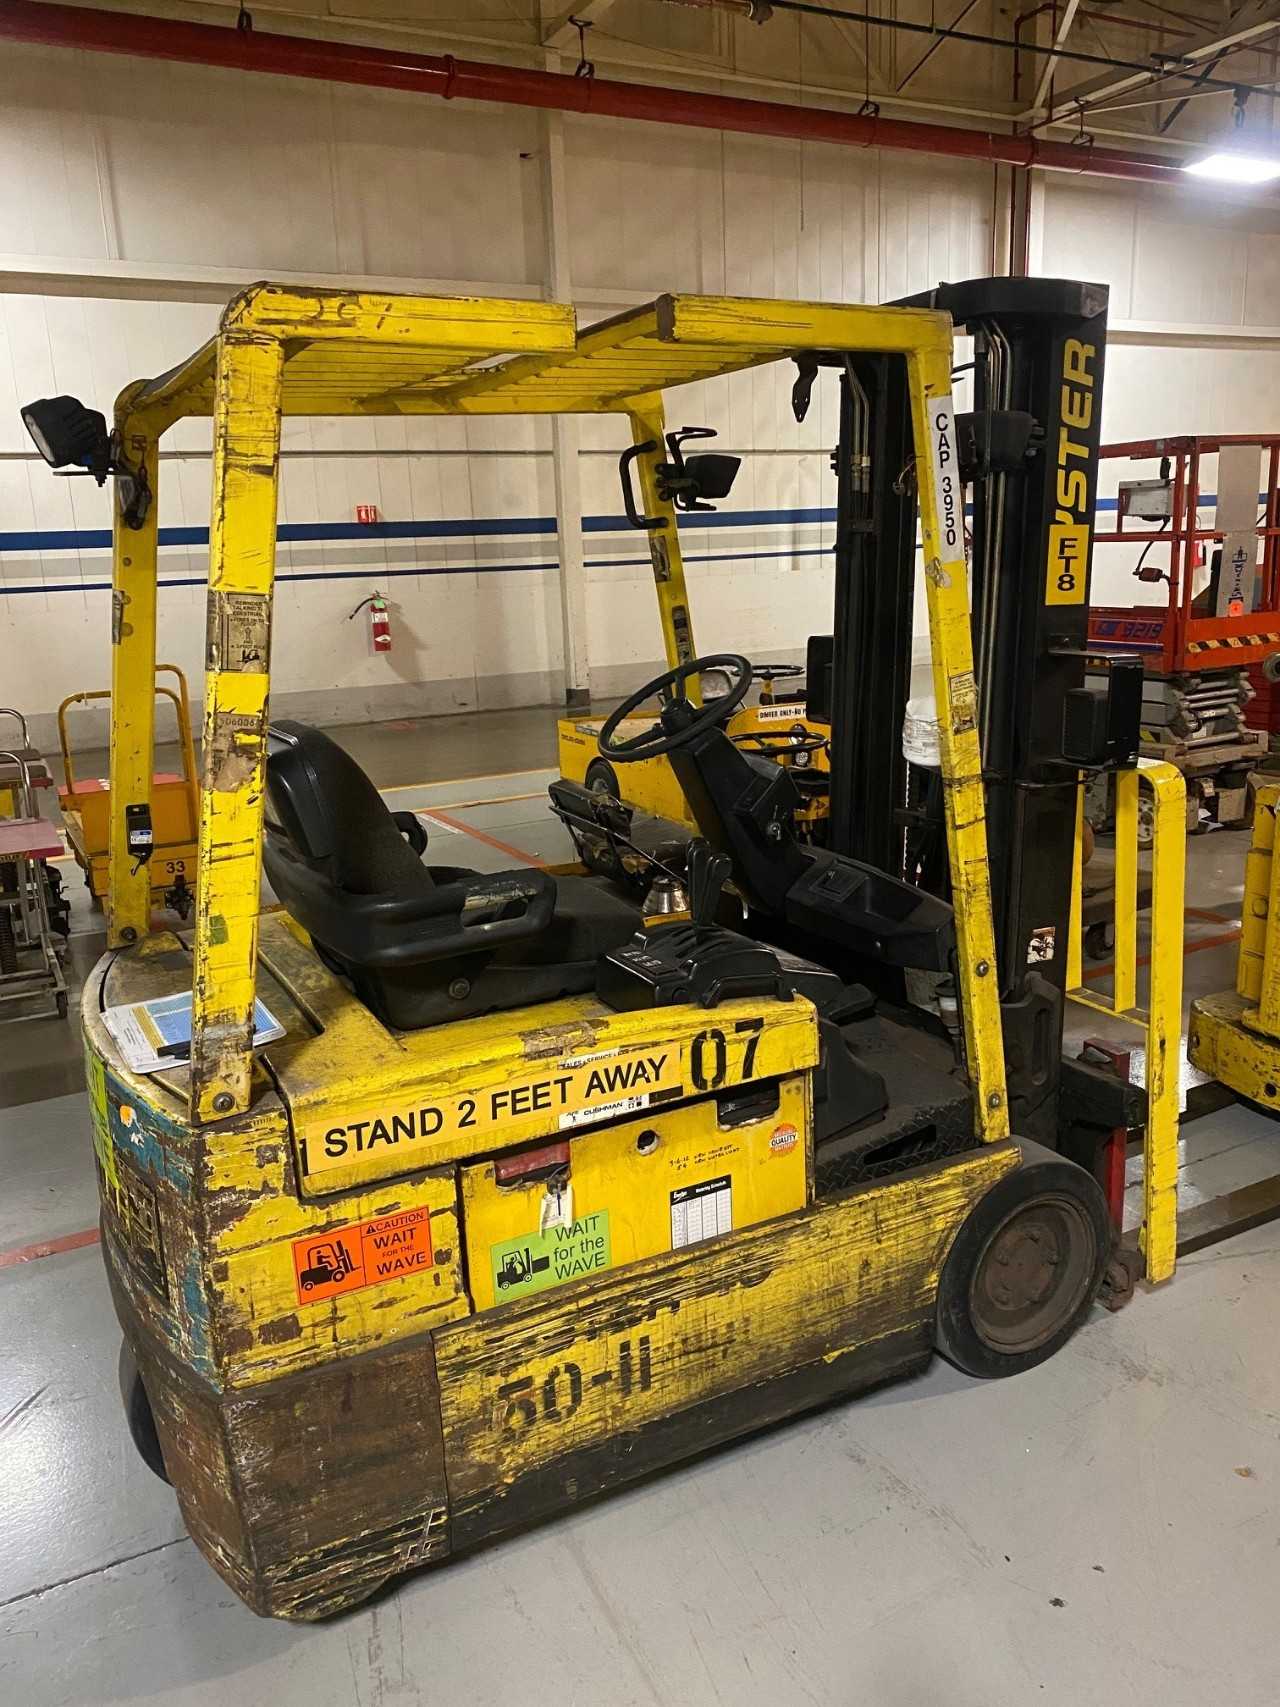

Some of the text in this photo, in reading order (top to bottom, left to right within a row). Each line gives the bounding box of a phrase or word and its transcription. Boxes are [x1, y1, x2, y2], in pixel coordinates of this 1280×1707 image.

[935, 413, 957, 546] CAP 3950
[166, 860, 185, 874] 33
[691, 1016, 764, 1091] 07
[324, 1054, 668, 1158] STAND 2 FEET AWAY
[770, 1133, 797, 1148] QUALITY
[376, 1211, 424, 1232] CAUTION
[555, 1215, 600, 1242] WAIT
[373, 1227, 417, 1249] WAIT
[554, 1236, 605, 1263] for the
[376, 1251, 426, 1275] WAVE
[382, 1244, 415, 1258] FOR THE
[554, 1250, 606, 1280] WAVE
